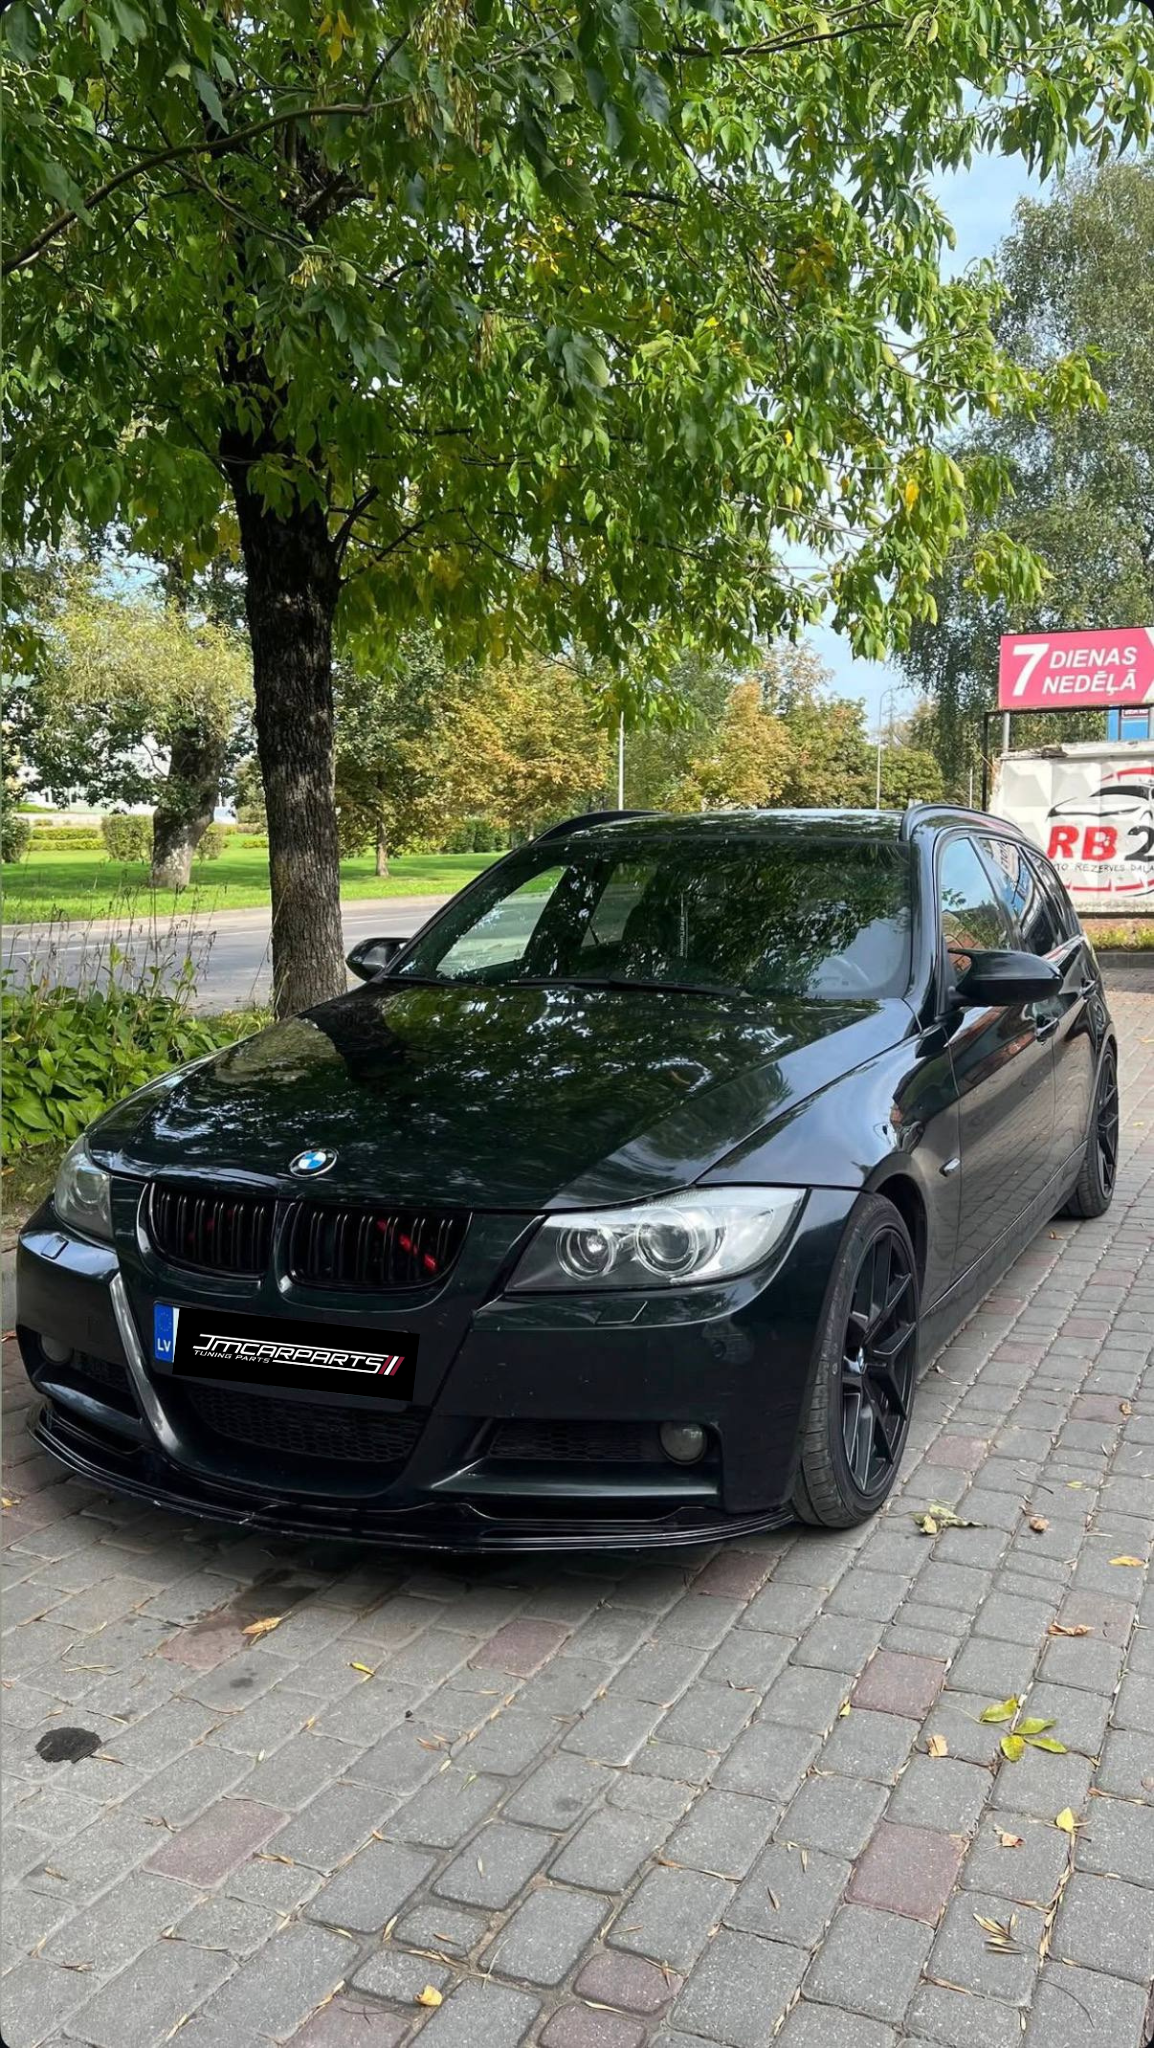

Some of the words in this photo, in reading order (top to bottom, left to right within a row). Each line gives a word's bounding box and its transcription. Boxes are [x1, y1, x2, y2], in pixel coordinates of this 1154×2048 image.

[1012, 643, 1050, 697] 7
[1049, 647, 1138, 669] DIENAS
[1041, 668, 1137, 696] NEDĒĻĀ
[1075, 863, 1125, 873] REZERVES
[157, 1338, 171, 1353] LV
